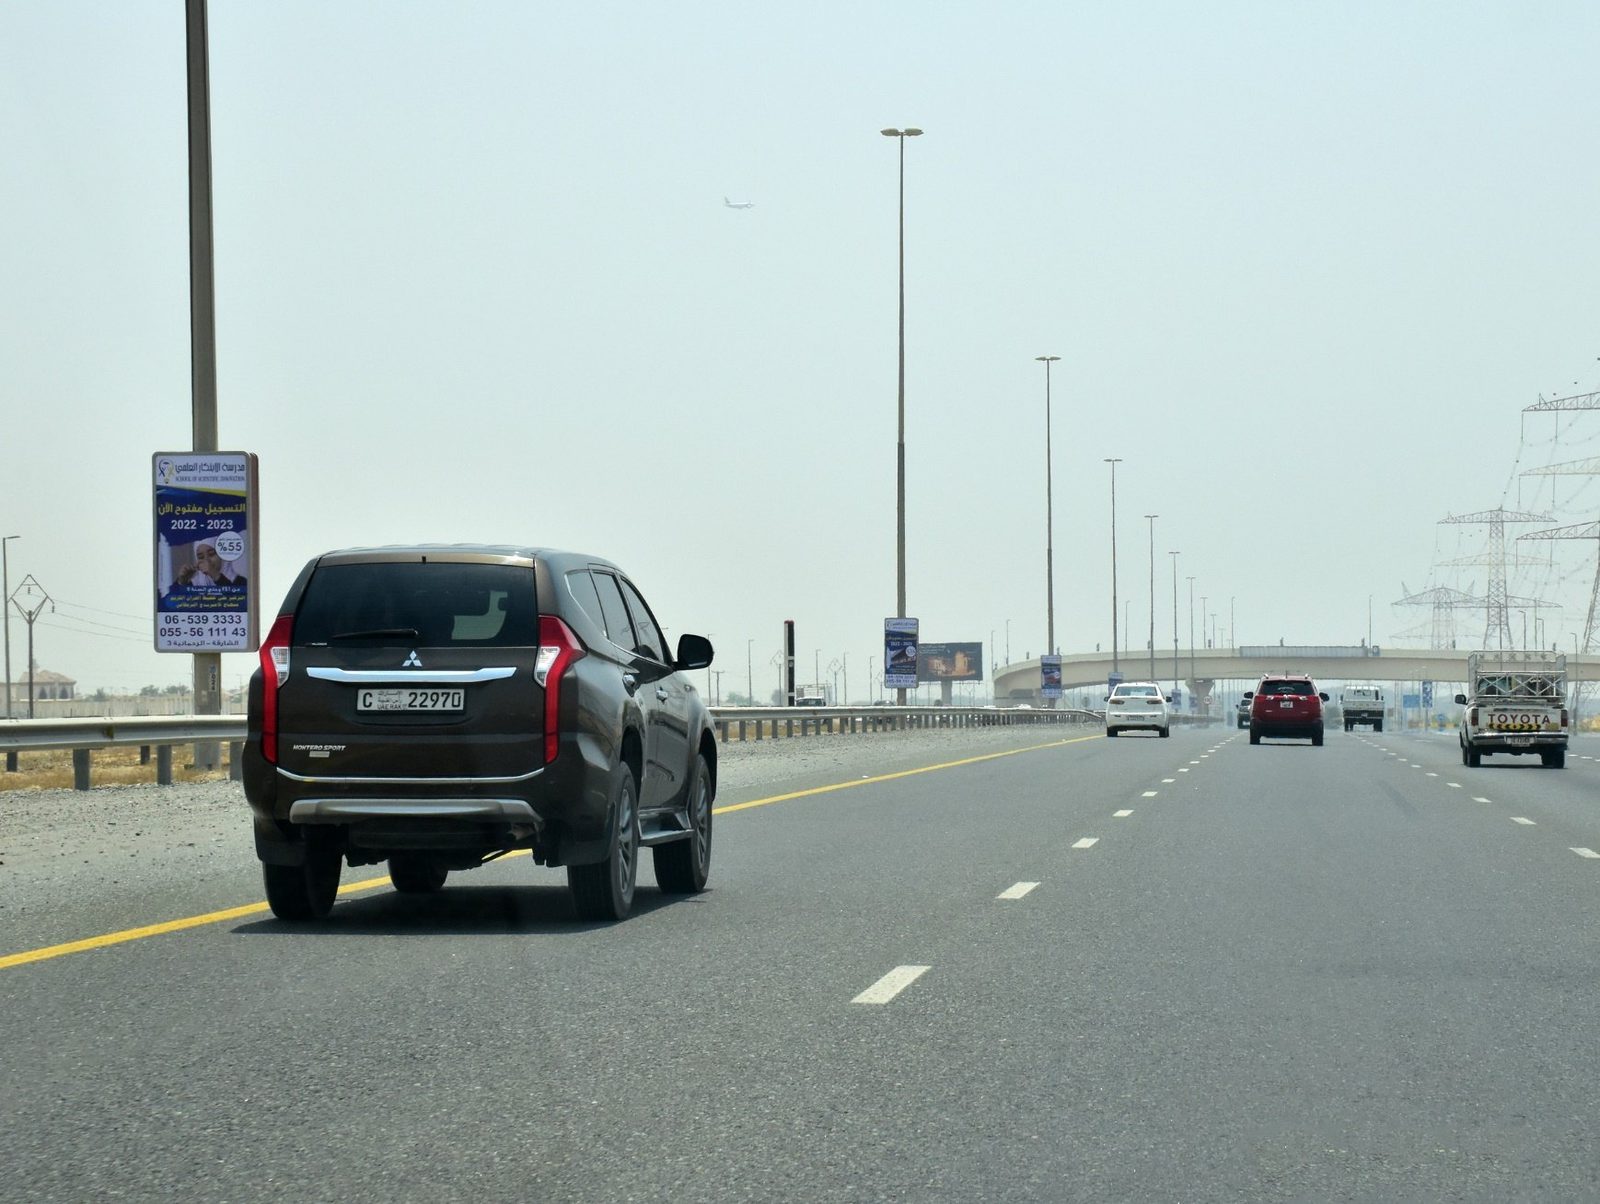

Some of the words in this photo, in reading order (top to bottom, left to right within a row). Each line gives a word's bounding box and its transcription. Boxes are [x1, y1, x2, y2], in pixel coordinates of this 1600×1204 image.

[175, 504, 203, 515] مفتوح
[204, 504, 246, 515] التسجيل
[171, 520, 197, 530] 2022
[207, 520, 233, 530] 2023
[213, 615, 242, 624] 3333
[208, 628, 226, 636] 111
[232, 628, 246, 636] 43
[363, 692, 372, 708] C
[408, 692, 461, 708] 22970
[1488, 714, 1550, 724] TOYOTA
